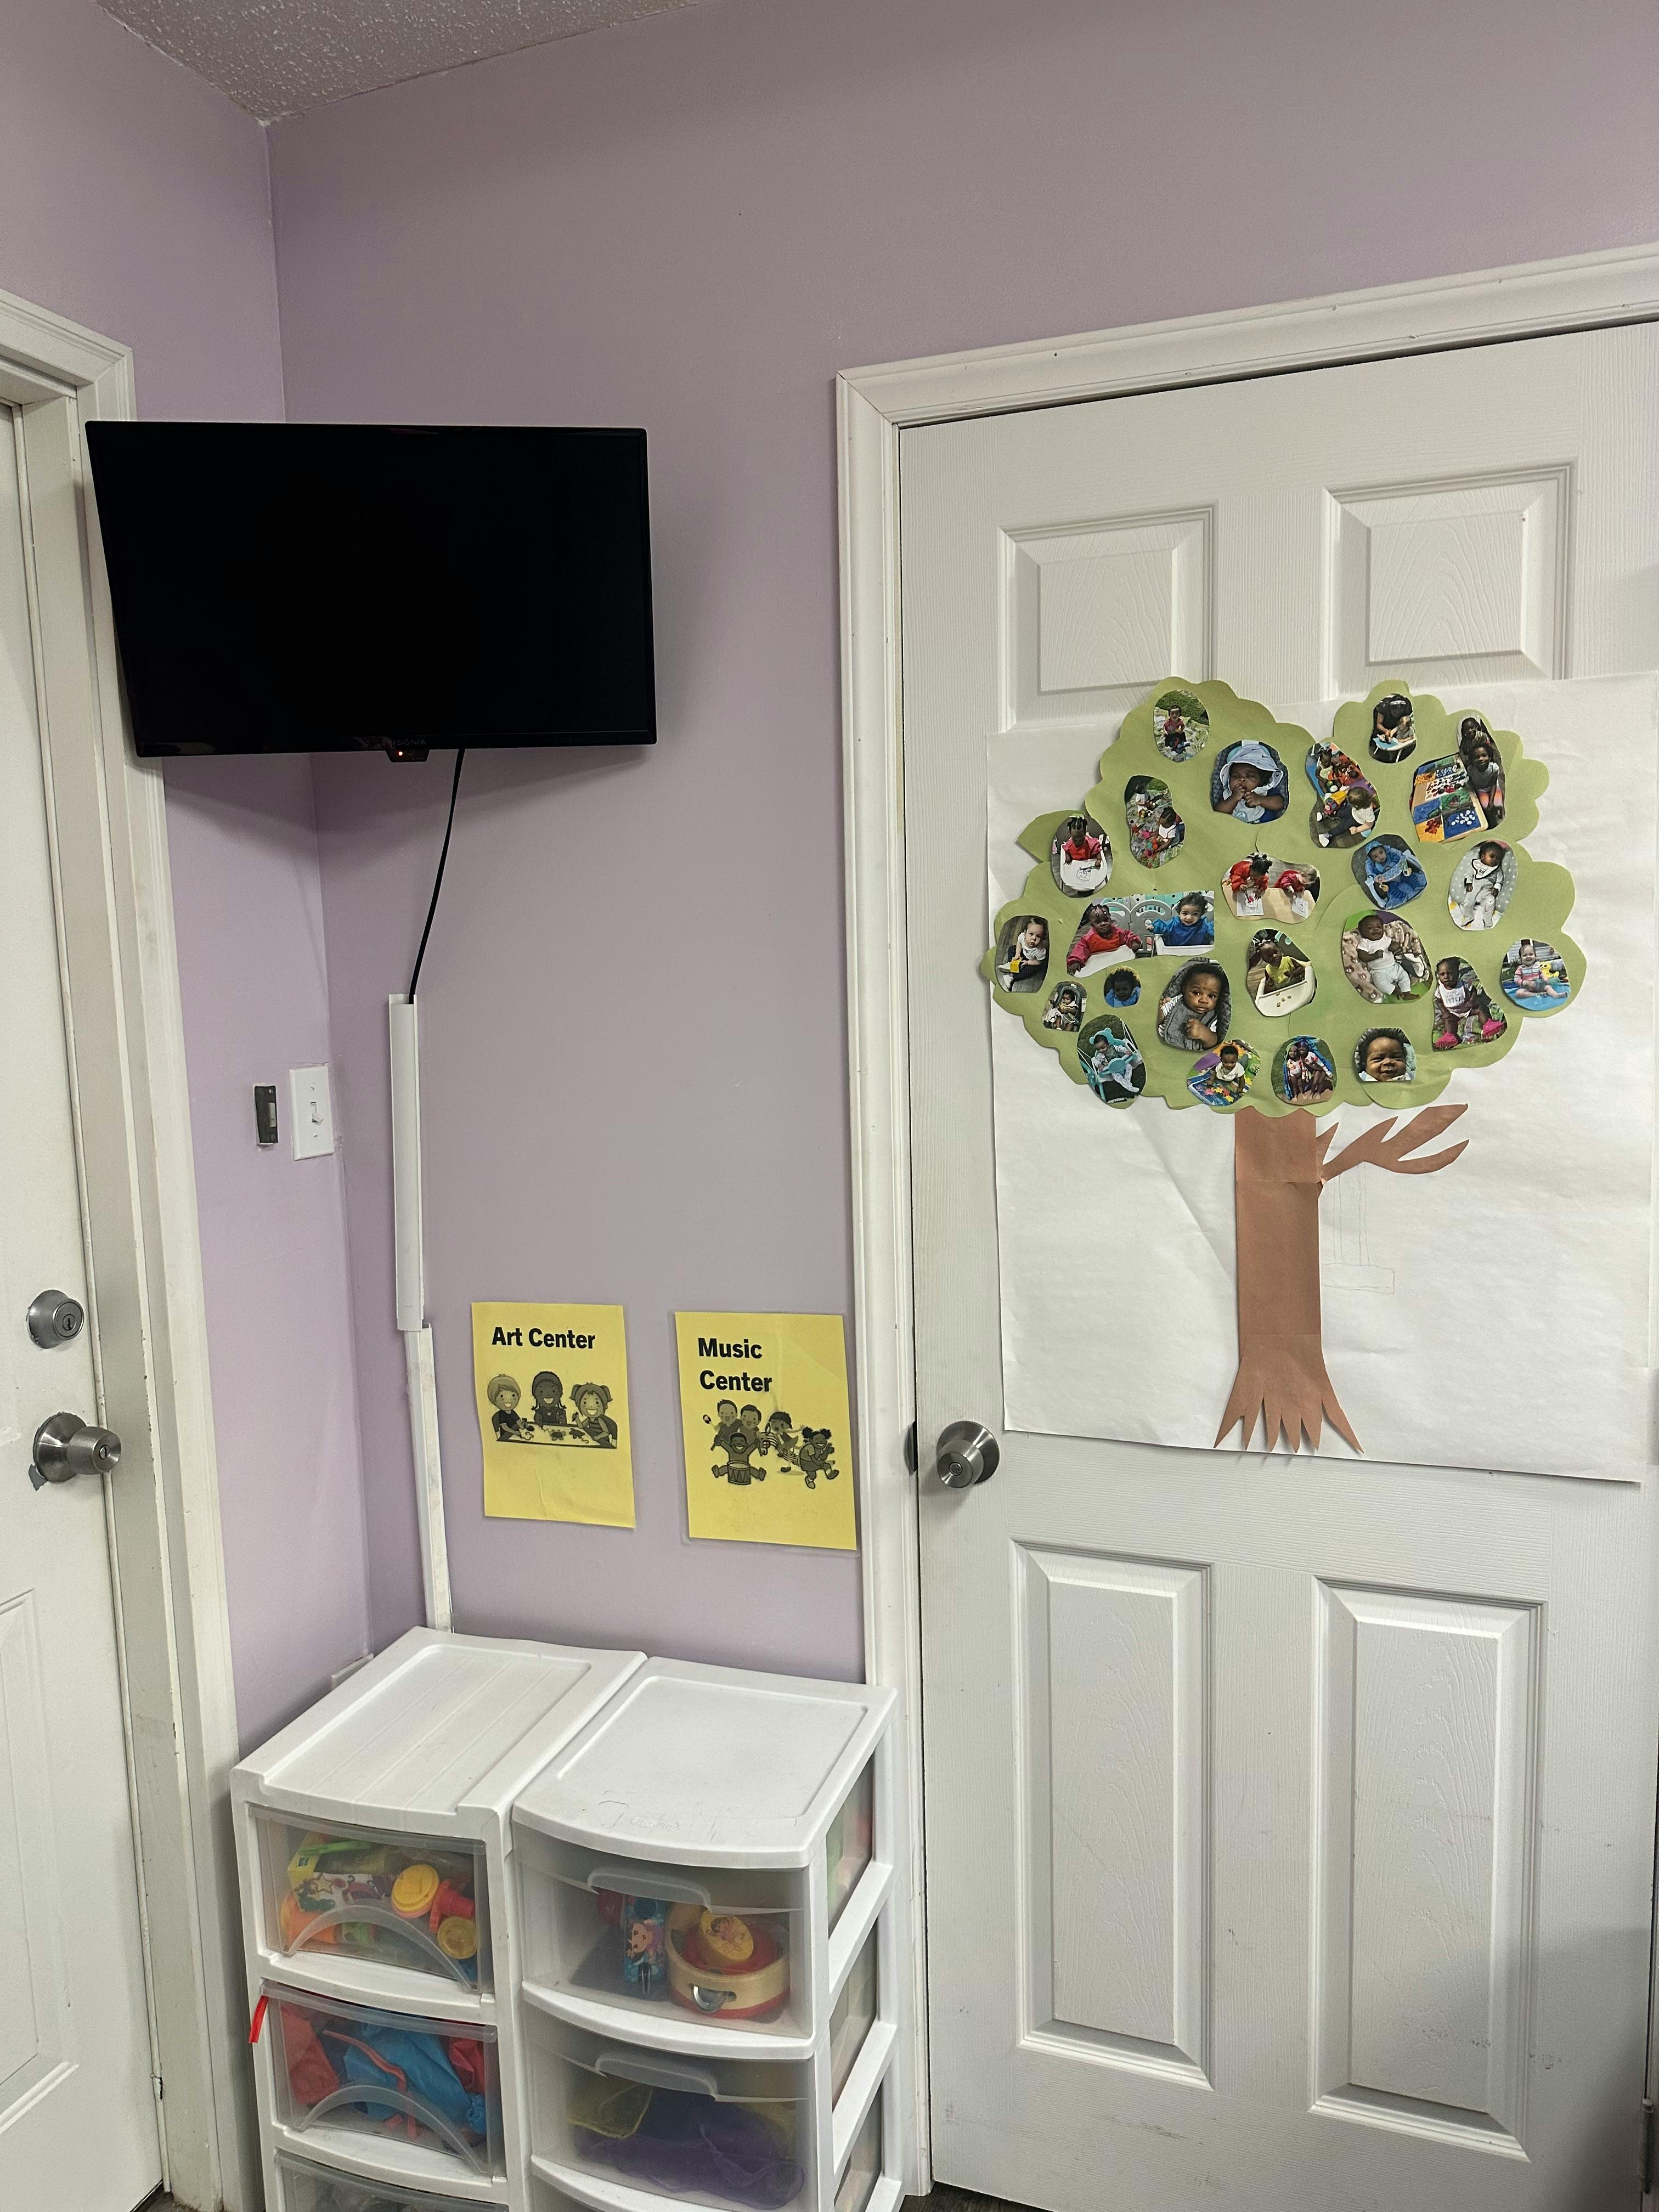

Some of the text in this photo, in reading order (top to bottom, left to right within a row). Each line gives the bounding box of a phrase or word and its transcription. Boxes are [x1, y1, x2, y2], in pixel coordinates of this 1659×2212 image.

[492, 1326, 596, 1350] Art Center
[698, 1337, 763, 1359] Music
[699, 1369, 772, 1392] Center
